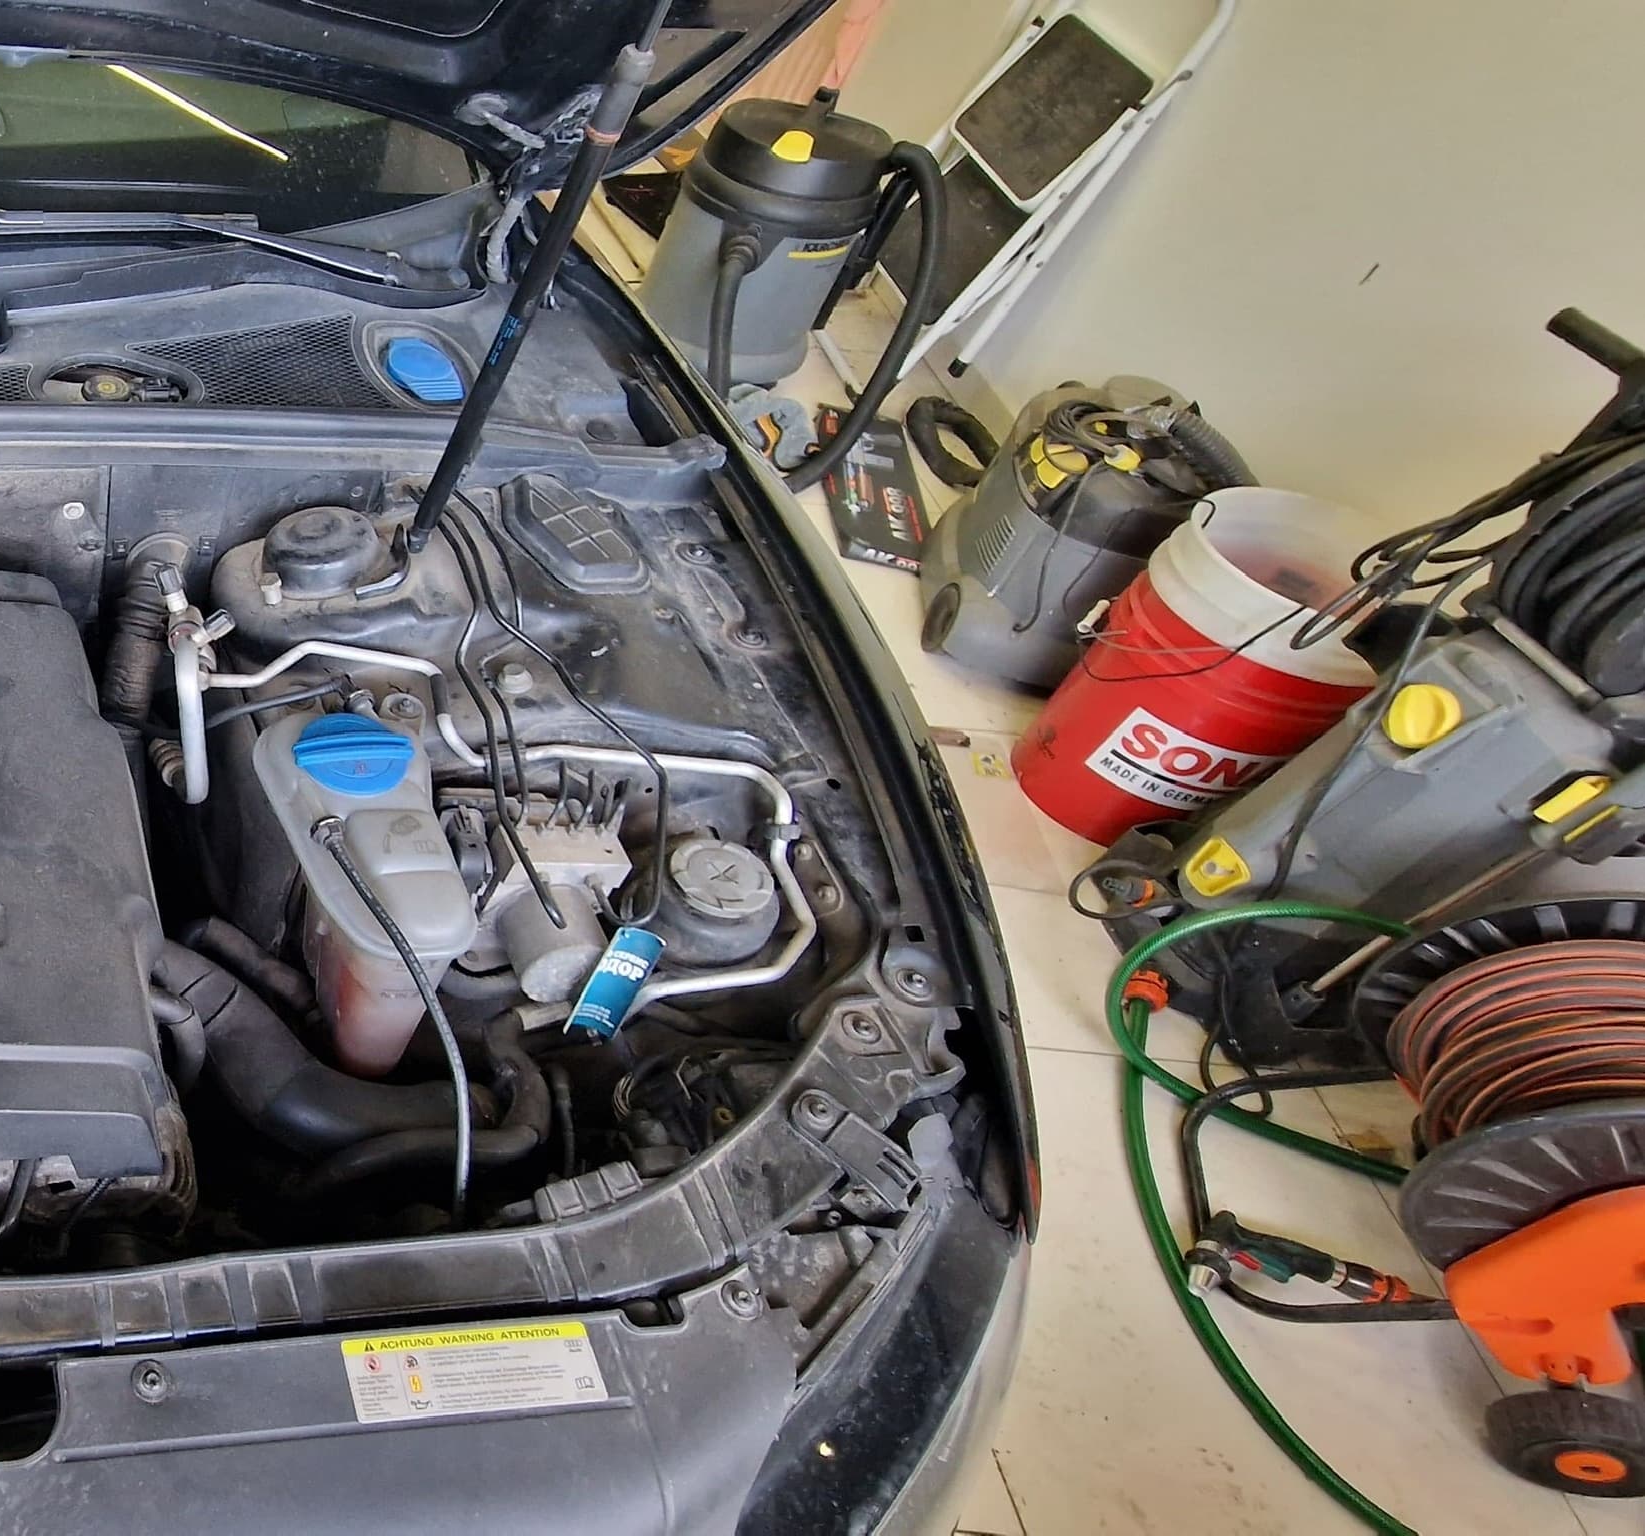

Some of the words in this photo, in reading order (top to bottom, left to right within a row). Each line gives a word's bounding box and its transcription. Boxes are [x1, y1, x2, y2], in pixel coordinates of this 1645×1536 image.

[885, 486, 905, 514] 998
[887, 513, 911, 541] AK
[1120, 723, 1279, 788] SON
[1099, 757, 1138, 783] MADE
[1141, 779, 1161, 793] IN
[379, 1337, 434, 1351] ACHTUNG
[440, 1331, 494, 1345] WARNING
[500, 1327, 560, 1340] ATTENTION
